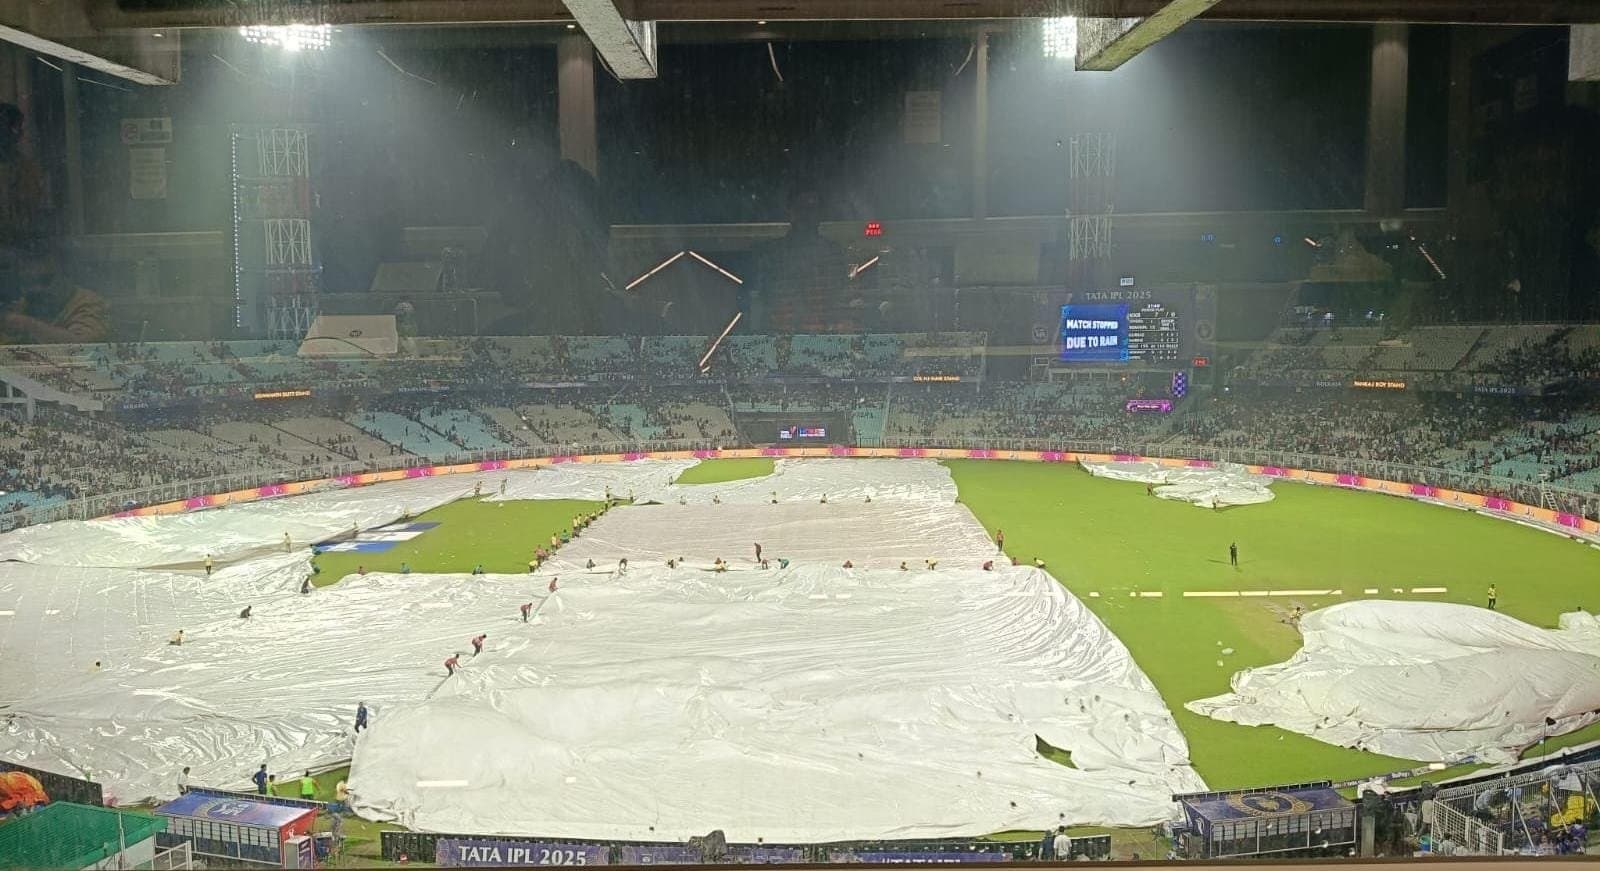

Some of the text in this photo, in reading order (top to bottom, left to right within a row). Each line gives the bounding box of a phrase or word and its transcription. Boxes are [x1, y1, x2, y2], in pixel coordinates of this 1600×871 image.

[1086, 291, 1152, 300] TATA IPL 2025
[1066, 319, 1092, 329] MATCH
[1092, 320, 1118, 330] STOPPED
[1066, 336, 1087, 349] DUE
[1087, 335, 1099, 348] TO
[1099, 335, 1118, 347] RAIN
[458, 845, 587, 866] TATA IPL 2025
